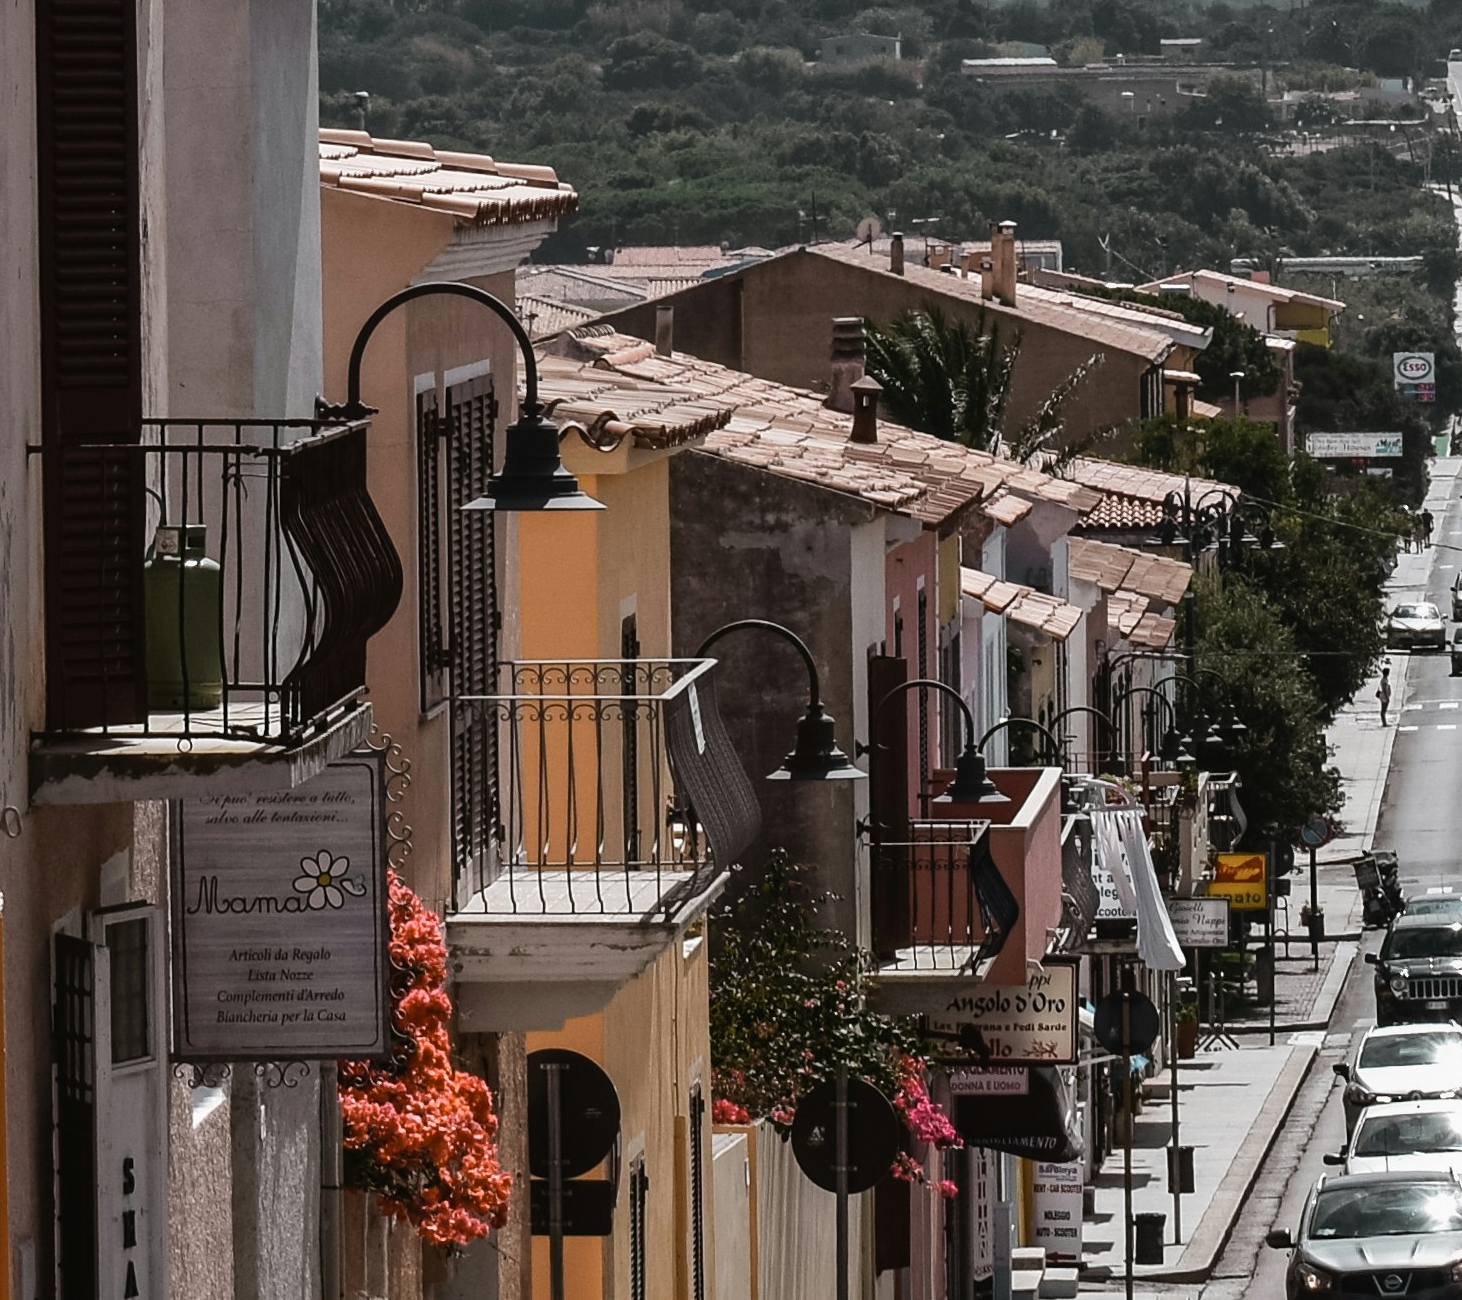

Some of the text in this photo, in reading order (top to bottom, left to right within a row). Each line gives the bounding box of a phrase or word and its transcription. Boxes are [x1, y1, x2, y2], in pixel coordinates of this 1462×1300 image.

[309, 795, 318, 804] a
[204, 809, 239, 825] salvo
[243, 809, 267, 824] alle
[228, 948, 331, 964] Articoli da Regalo
[247, 969, 314, 982] Lista Nozze
[216, 989, 345, 1006] Complementi d'Arredo
[946, 990, 1066, 1018] Angolo d'Oro
[216, 1009, 347, 1026] Biancheria per la Casa
[1038, 1022, 1067, 1032] Sarde
[994, 1079, 1021, 1091] UOMO
